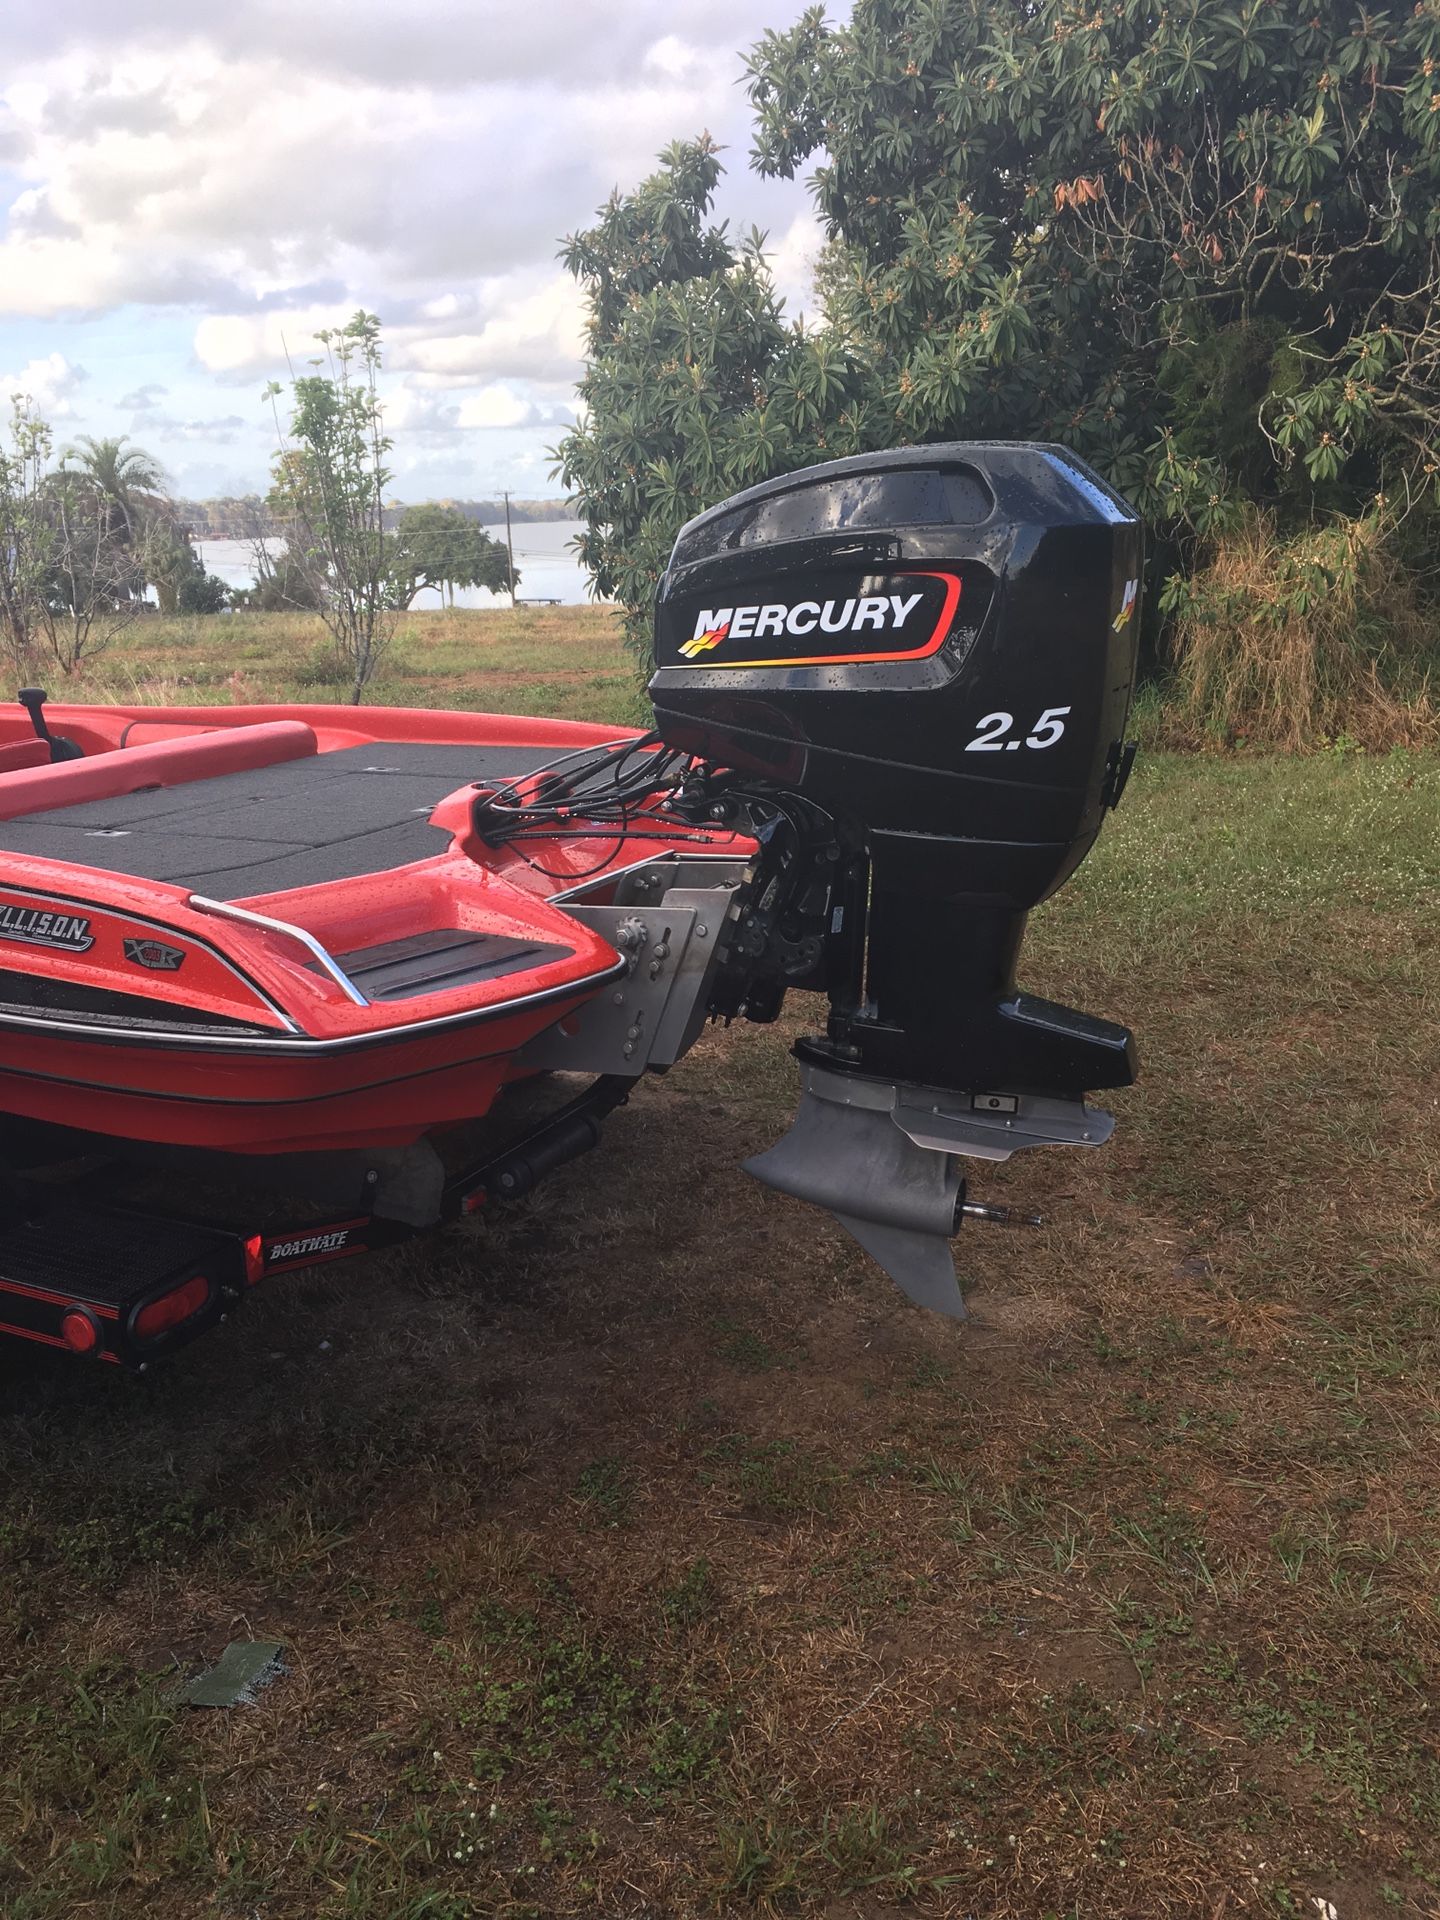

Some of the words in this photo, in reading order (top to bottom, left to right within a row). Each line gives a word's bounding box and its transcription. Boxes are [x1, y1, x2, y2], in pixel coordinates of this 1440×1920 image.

[684, 593, 924, 648] MERCURY
[964, 705, 1072, 752] 2.5
[269, 1230, 349, 1260] BOATMATE
